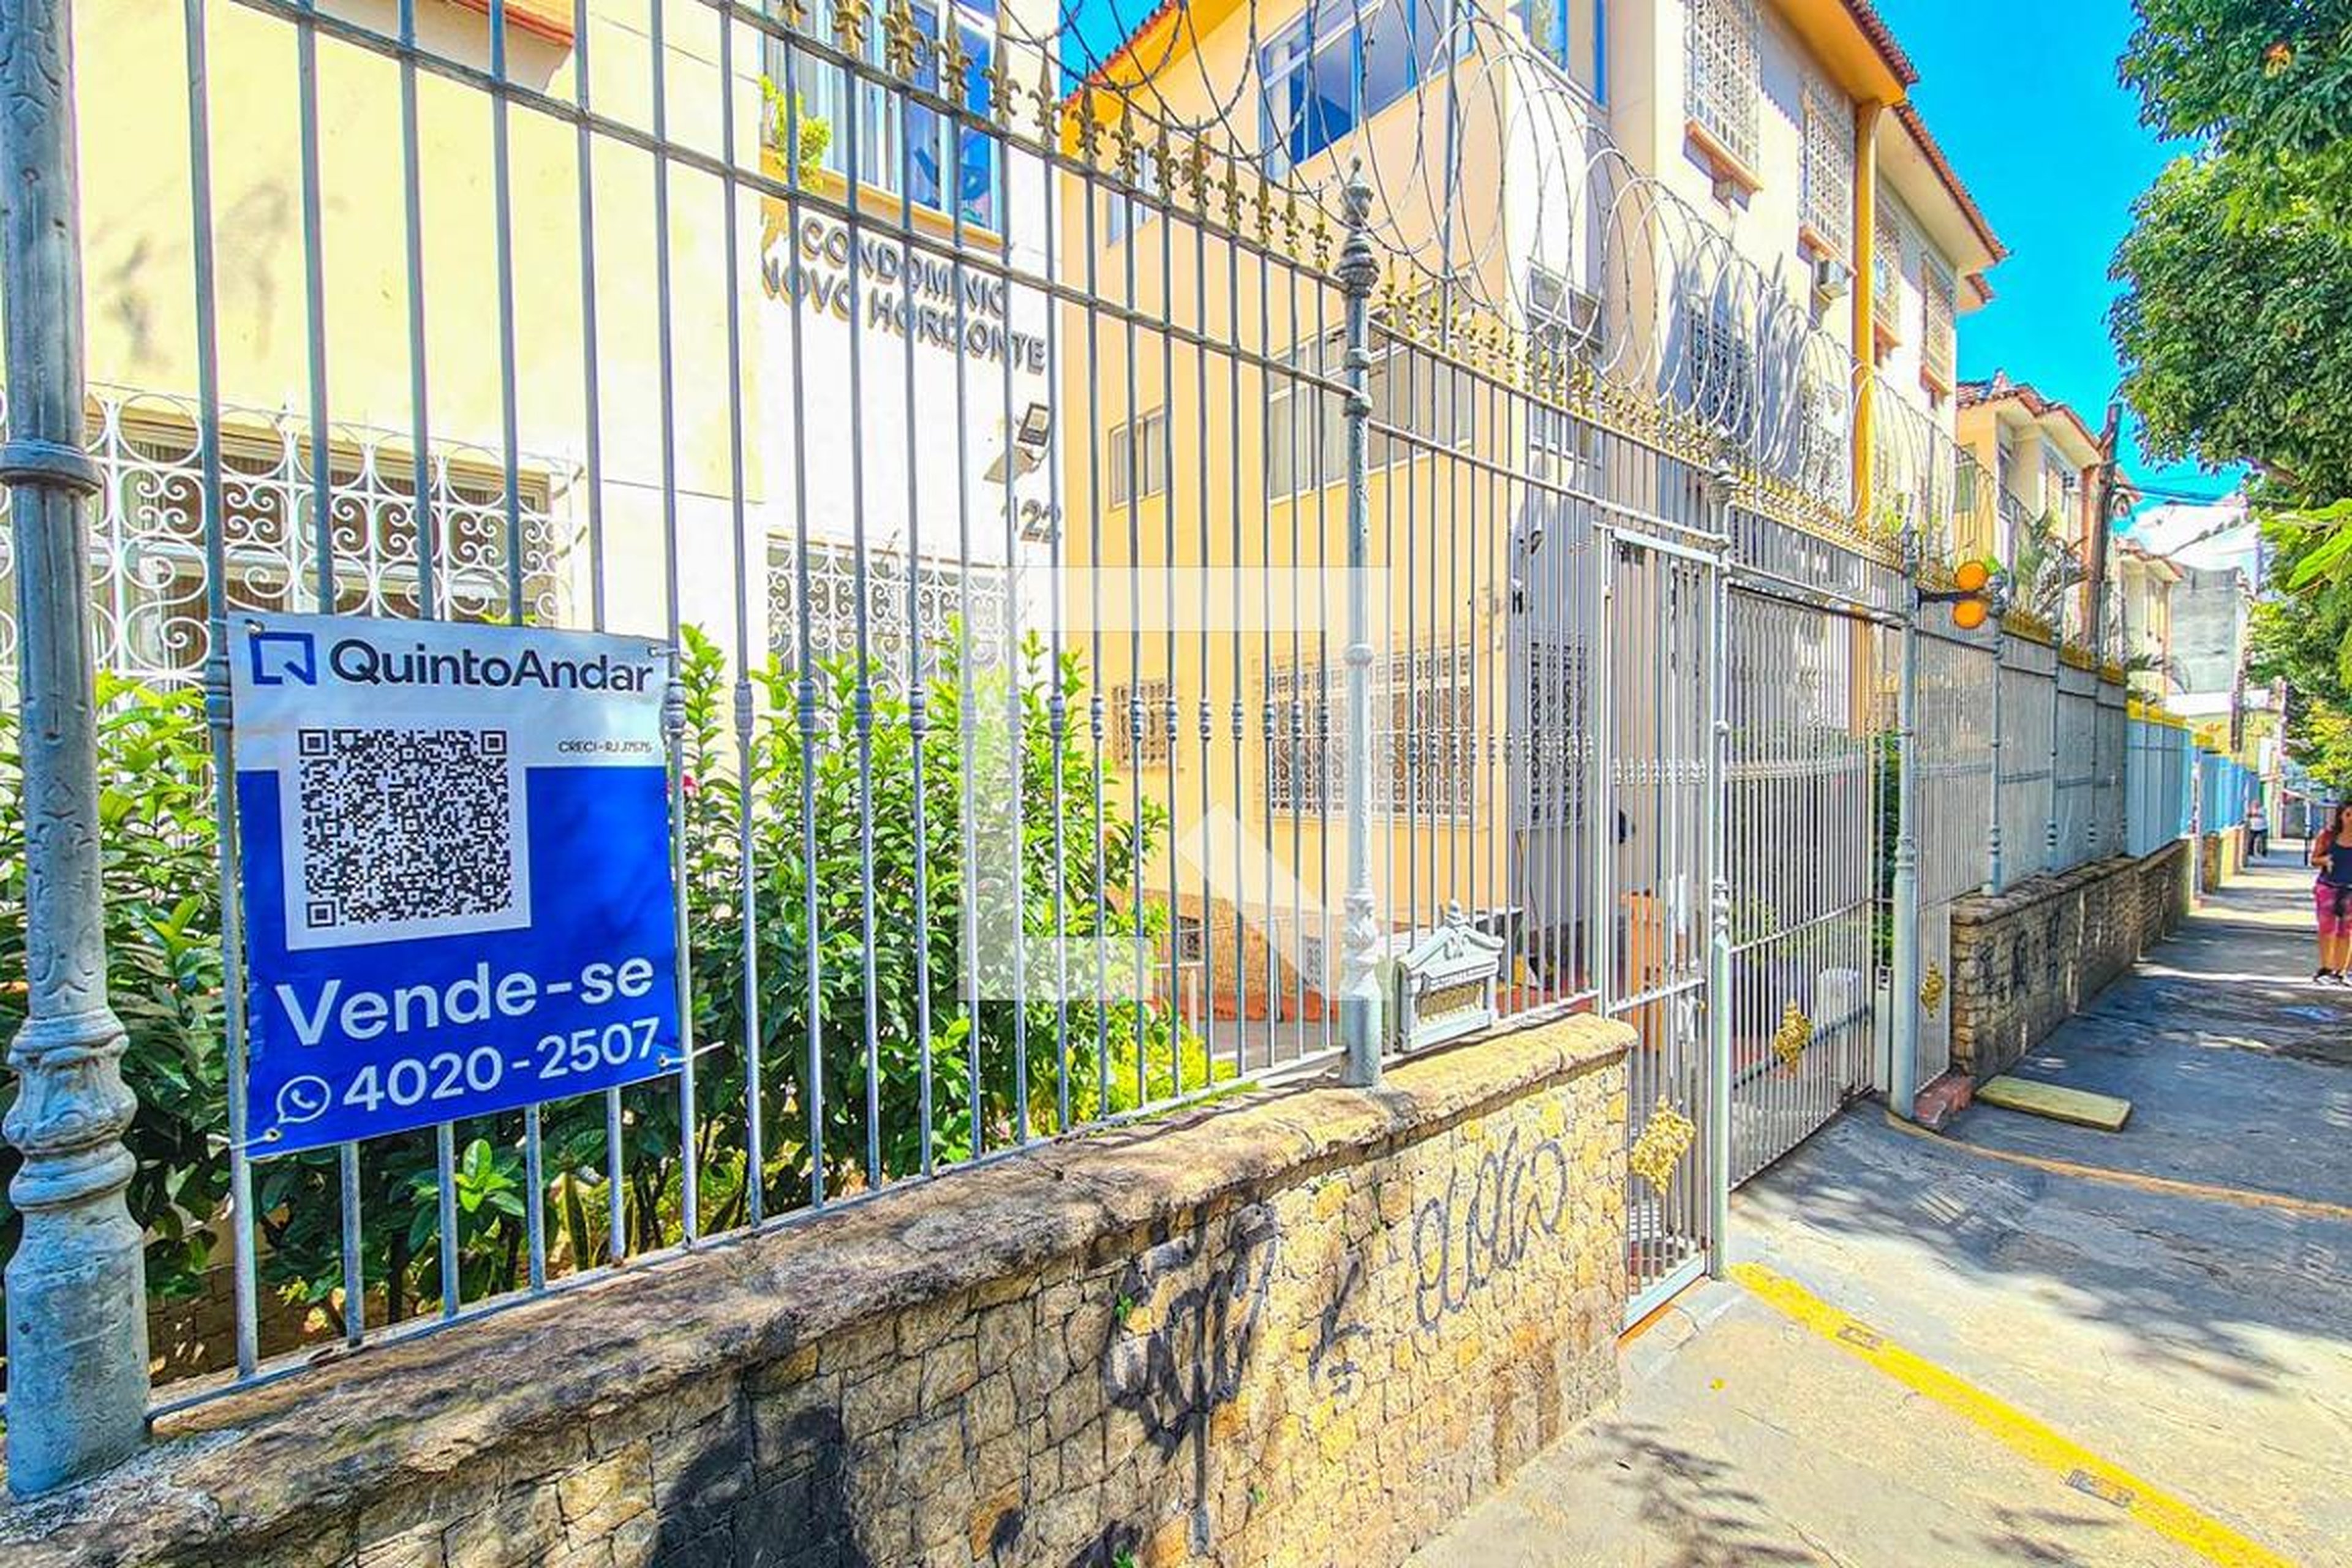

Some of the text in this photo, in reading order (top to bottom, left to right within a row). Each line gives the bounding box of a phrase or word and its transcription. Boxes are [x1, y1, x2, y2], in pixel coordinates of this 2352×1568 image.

[329, 638, 654, 692] QuintoAndar
[275, 957, 654, 1046] Vende-se
[342, 1016, 660, 1112] 4020-2507
